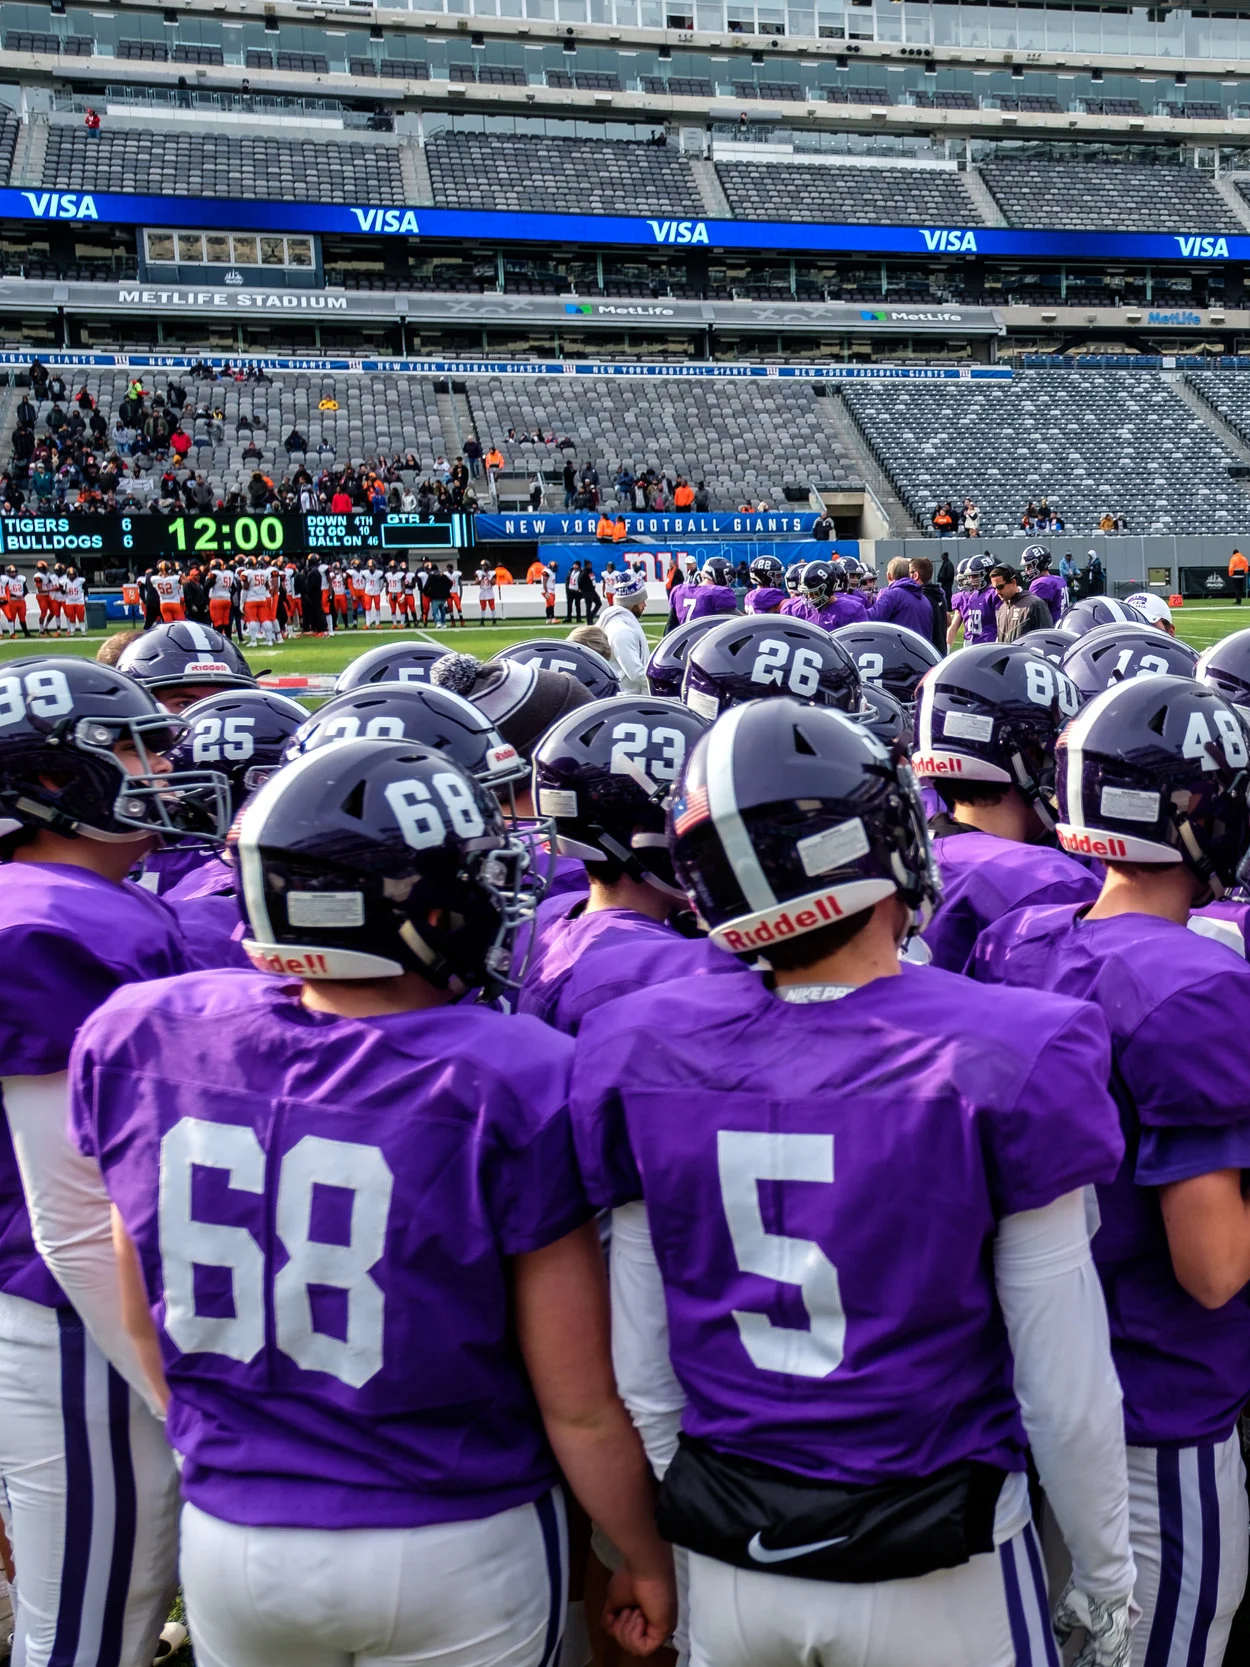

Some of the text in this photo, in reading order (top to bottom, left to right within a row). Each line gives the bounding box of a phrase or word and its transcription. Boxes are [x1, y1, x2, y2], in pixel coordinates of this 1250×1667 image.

[21, 192, 99, 219] VISA
[350, 207, 419, 234] VISA
[646, 219, 709, 244] VISA
[919, 229, 977, 251] VISA
[1174, 236, 1229, 257] VISA
[118, 290, 348, 309] METLIFE STADIUM
[598, 305, 674, 317] MetLife
[891, 311, 962, 322] MetLife
[1148, 312, 1201, 325] MetLife
[150, 358, 172, 367] NEW
[289, 360, 331, 370] GIANTS
[378, 362, 547, 373] NEW YORK FOOTBALL GIANTS
[593, 365, 752, 376] NEW YORK FOOTBALL GIANTS
[795, 368, 945, 378] NEW YORK FOOTBALL GIANTS
[5, 518, 132, 533] TIGERS 6
[307, 515, 373, 526] DOWN 4TH
[387, 514, 435, 525] QTR 2
[505, 517, 802, 534] NEW YOR FOOTBALL GIANTS
[168, 516, 284, 551] 12:00
[308, 526, 370, 536] TO GO 10
[8, 534, 134, 549] BULLDOGS 6
[309, 535, 379, 546] BALL ON 46
[1033, 547, 1045, 557] 21
[157, 583, 173, 594] 52
[683, 597, 697, 623] 7
[750, 639, 824, 698] 26
[850, 652, 884, 689] 2
[1025, 661, 1079, 717] 80
[192, 717, 256, 763] 25
[1182, 710, 1249, 771] 48
[611, 722, 686, 780] 23
[912, 757, 963, 775] iddell
[384, 772, 486, 850] 68
[723, 895, 844, 952] Riddell
[784, 987, 823, 1004] NIKE
[157, 1116, 395, 1389] 68
[717, 1130, 846, 1379] 5
